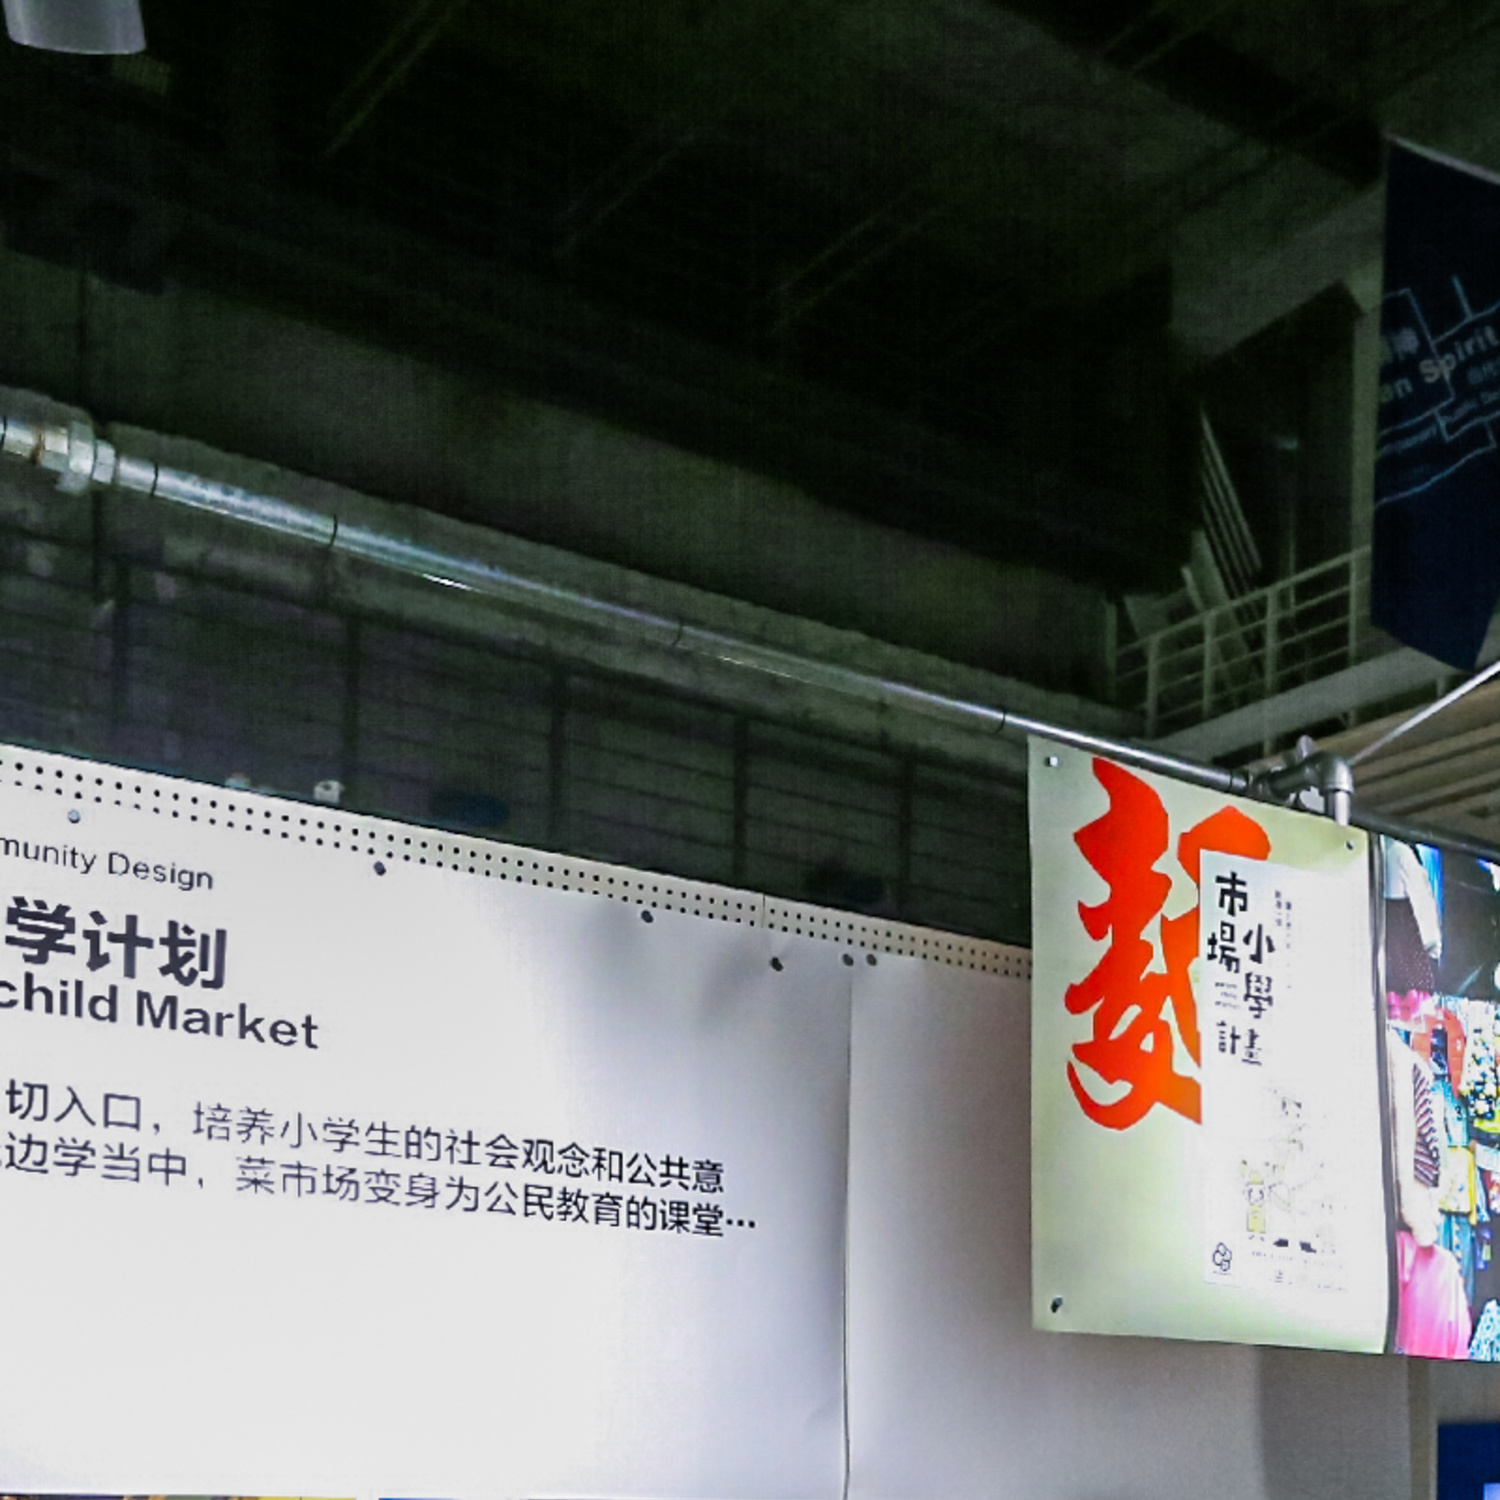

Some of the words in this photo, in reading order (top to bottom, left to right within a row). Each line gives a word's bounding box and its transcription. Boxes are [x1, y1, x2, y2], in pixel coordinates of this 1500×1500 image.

[1418, 325, 1500, 384] Spirit
[107, 850, 215, 892] Design
[4, 895, 229, 991] 学计划
[135, 990, 320, 1051] Market
